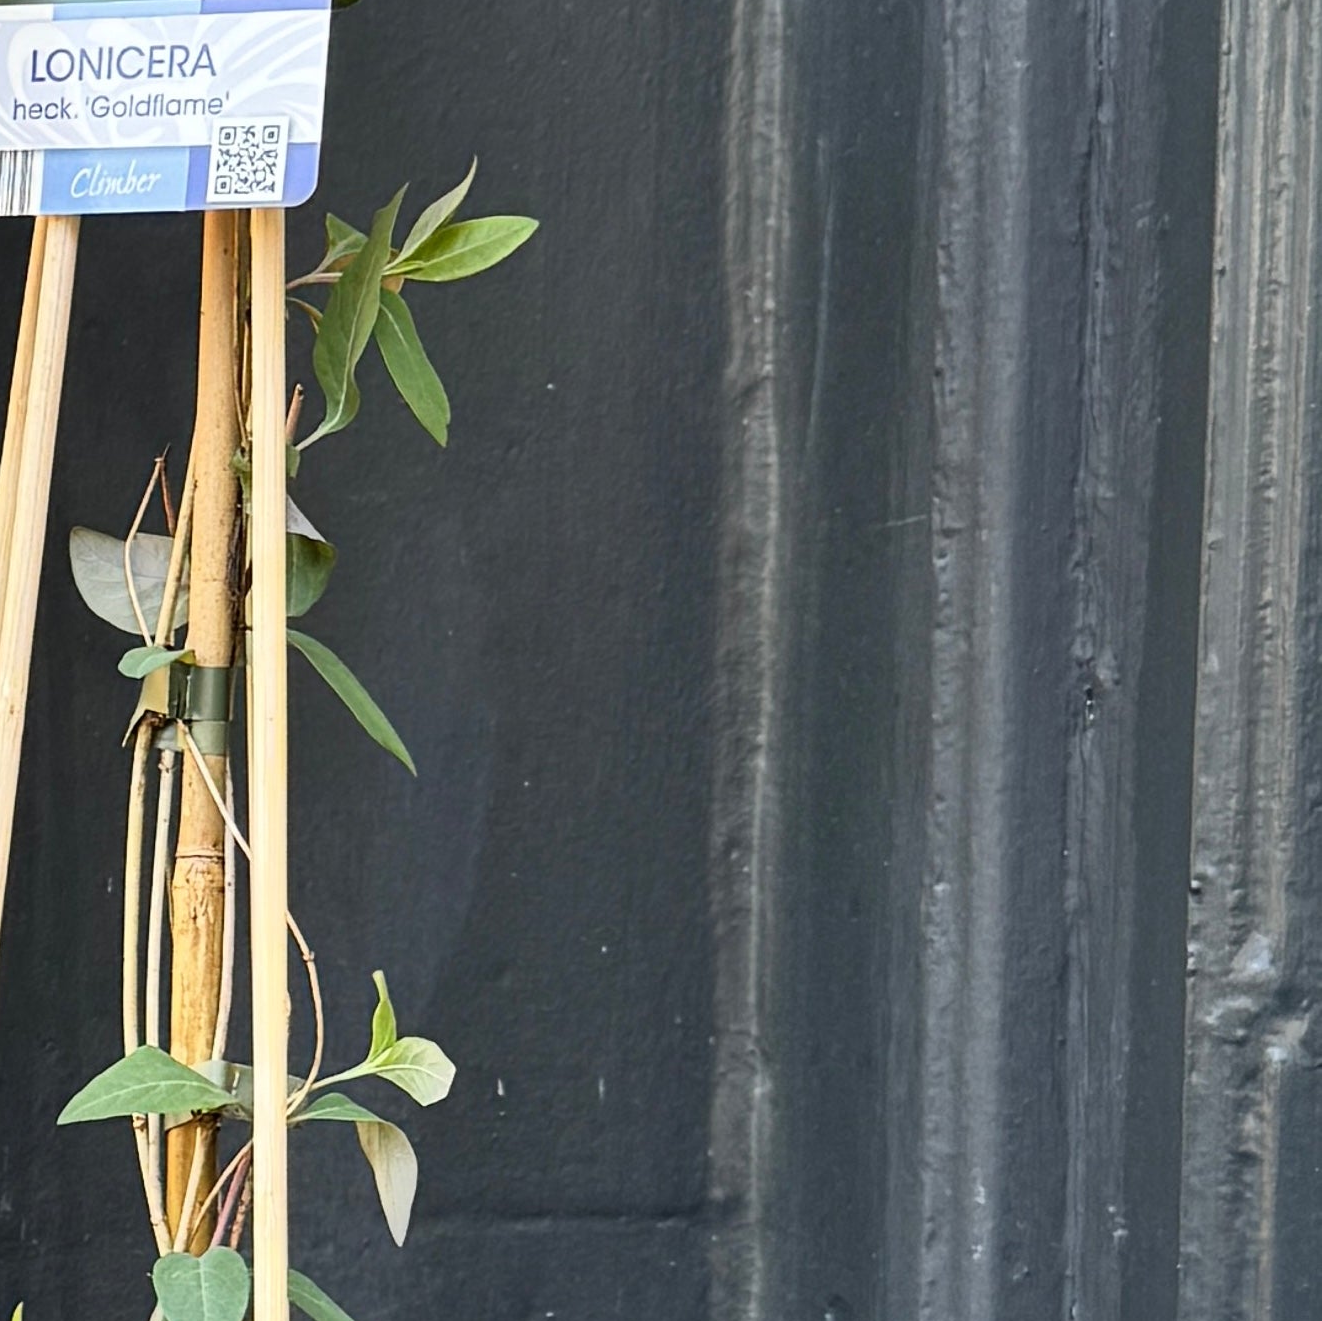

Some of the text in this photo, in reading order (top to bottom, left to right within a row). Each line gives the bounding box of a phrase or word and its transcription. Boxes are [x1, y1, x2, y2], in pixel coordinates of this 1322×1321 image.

[31, 43, 217, 83] LONICERA
[13, 90, 231, 121] heck. 'Goldflame'
[70, 160, 161, 200] Climber
